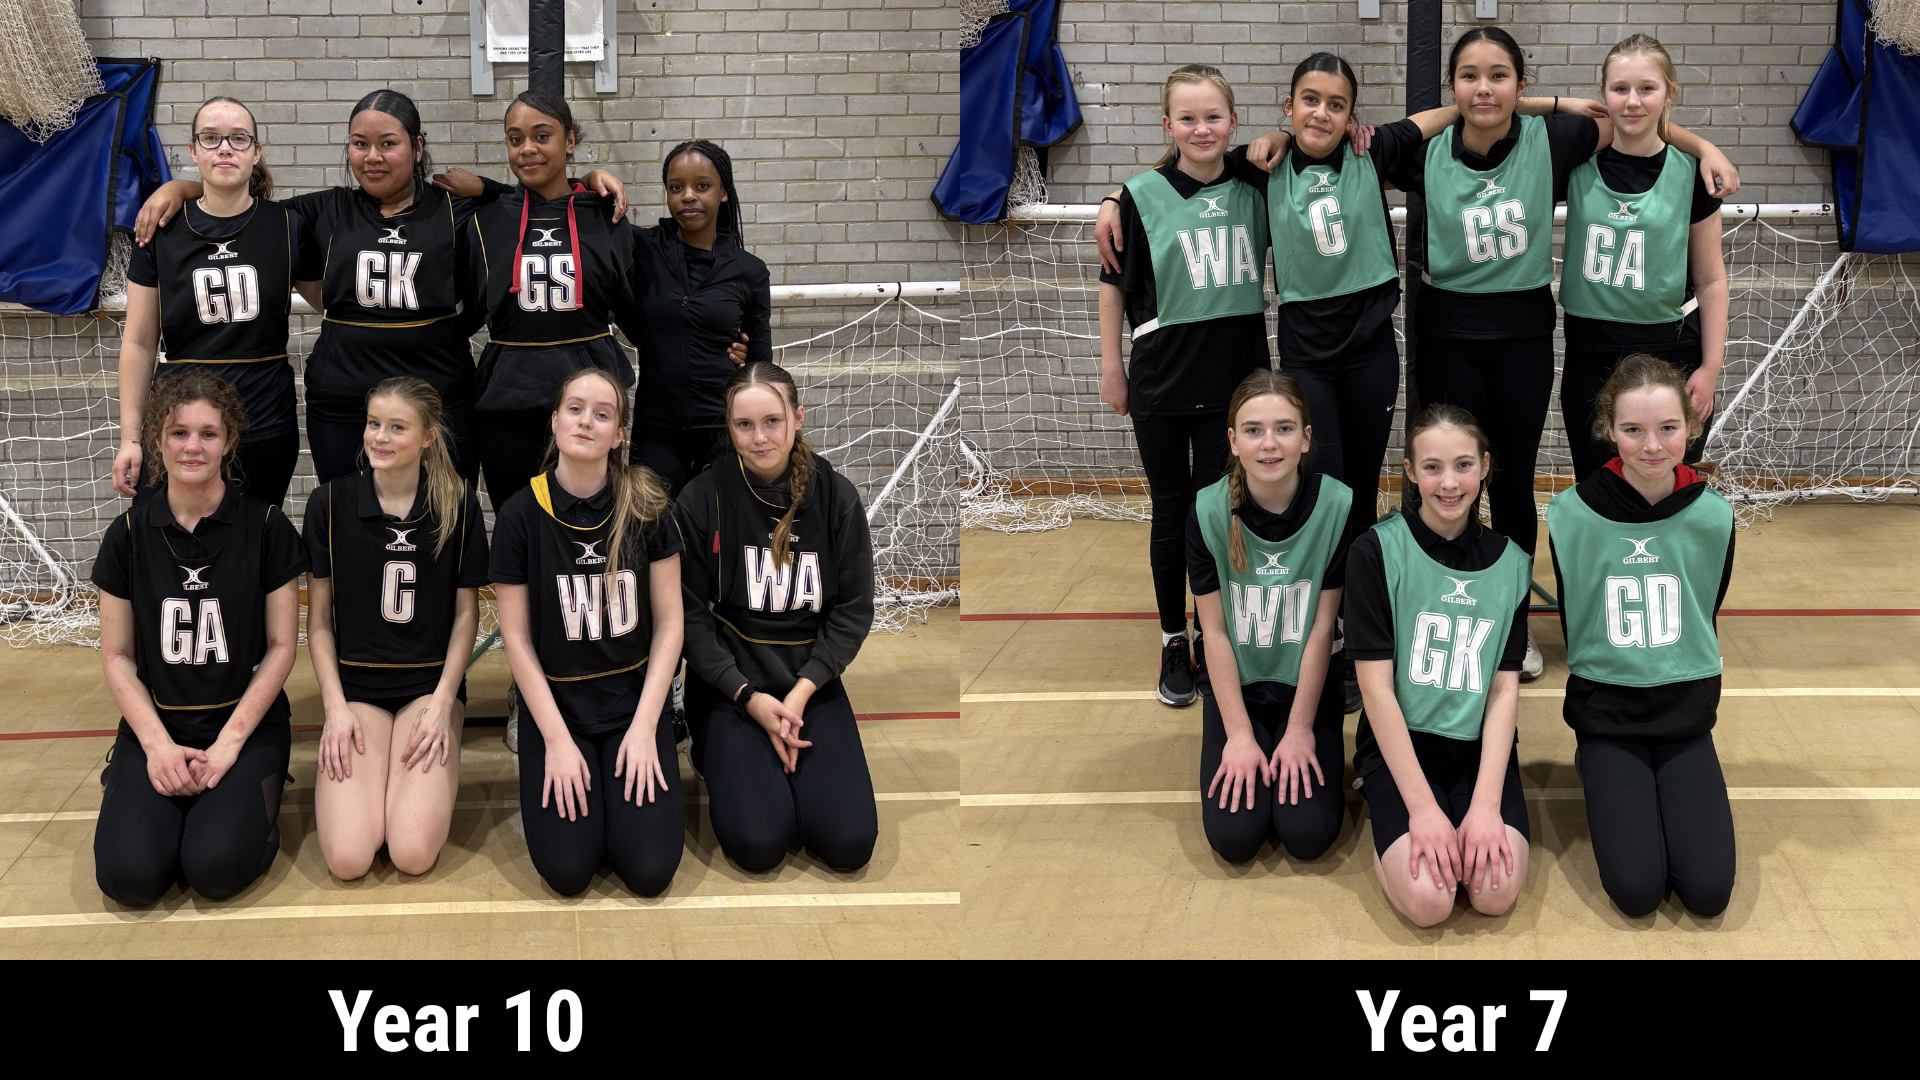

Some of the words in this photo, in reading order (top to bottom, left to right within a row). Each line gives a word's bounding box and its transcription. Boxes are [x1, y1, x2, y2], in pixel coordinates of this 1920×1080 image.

[1476, 187, 1506, 199] GILBERT
[1607, 213, 1638, 222] GILBERT
[208, 252, 238, 261] GILBERT
[378, 237, 407, 245] GILBERT
[1308, 195, 1347, 257] C
[1461, 199, 1528, 264] GS
[355, 250, 423, 310] GK
[517, 253, 577, 312] GS
[1176, 224, 1259, 290] WA
[1582, 223, 1645, 291] GA
[192, 264, 260, 325] GD
[385, 544, 417, 552] GILBERT
[575, 557, 607, 565] GILBERT
[1255, 567, 1290, 575] GILBERT
[1622, 556, 1660, 565] GILBERT
[381, 560, 416, 623] C
[556, 569, 639, 641] WD
[744, 545, 823, 613] WA
[1440, 594, 1478, 606] GILBERT
[160, 597, 229, 664] GA
[1228, 579, 1312, 648] WD
[1605, 573, 1682, 648] GD
[1408, 611, 1495, 694] GK
